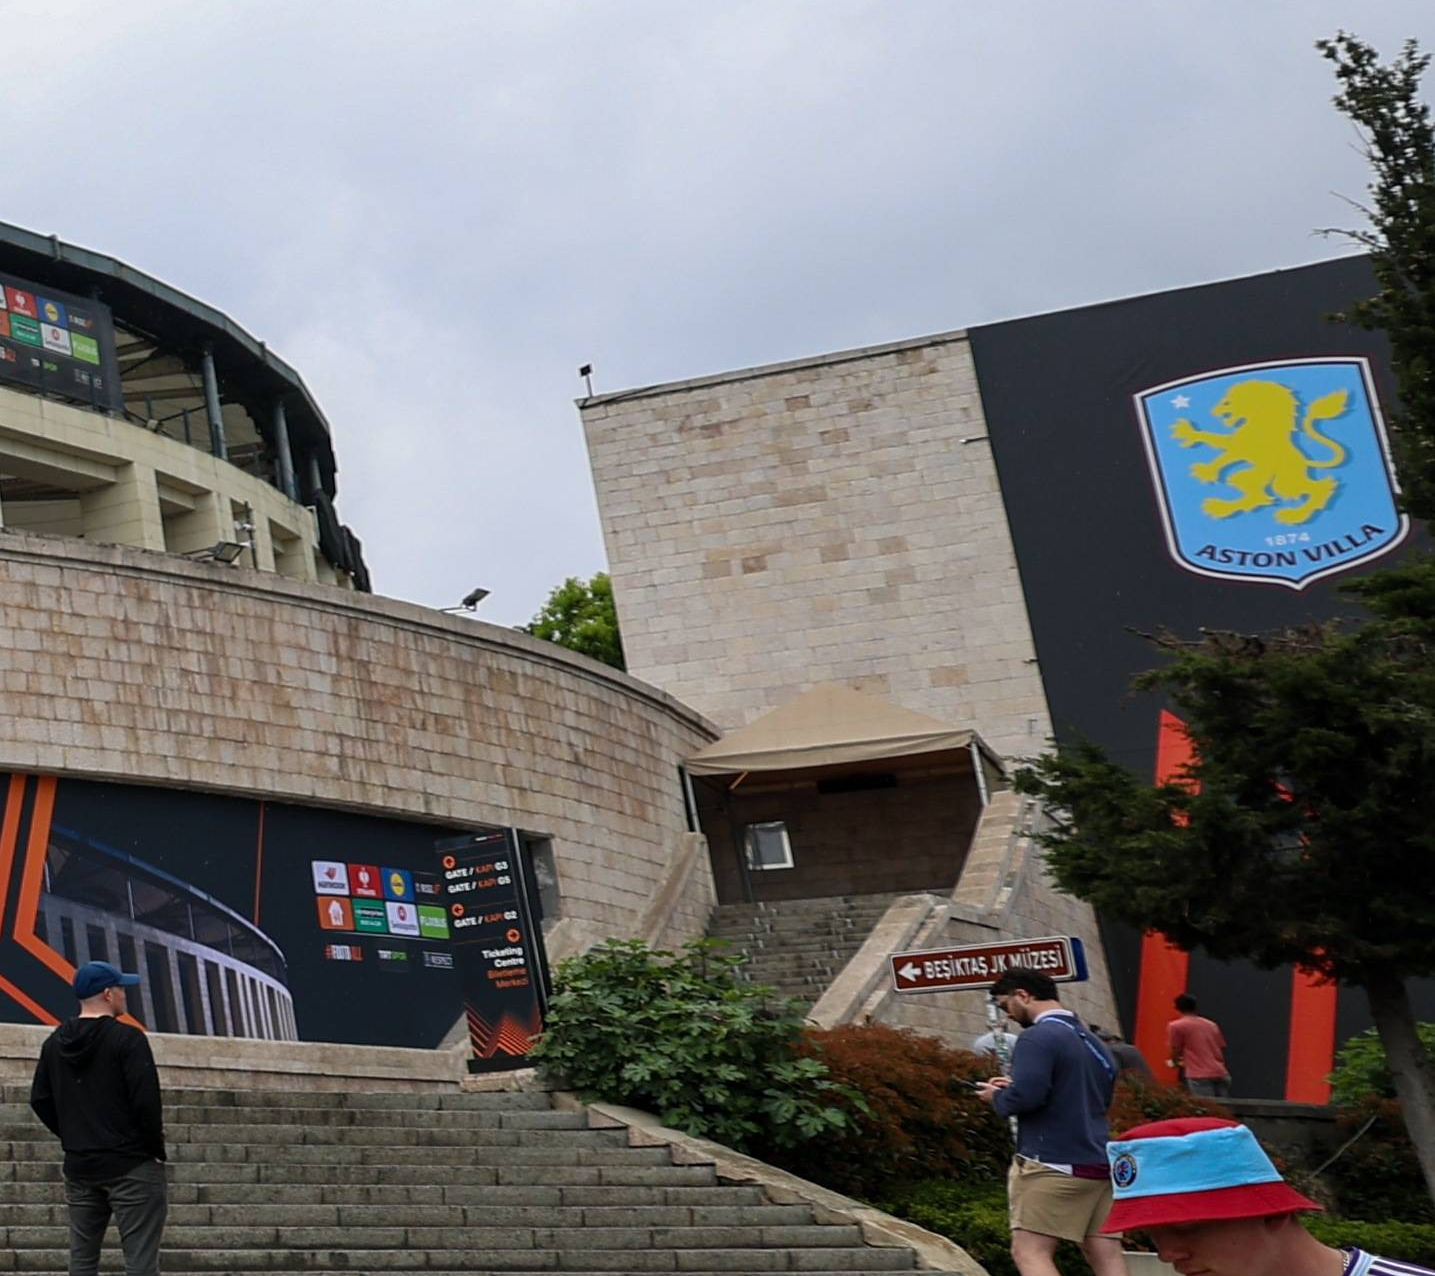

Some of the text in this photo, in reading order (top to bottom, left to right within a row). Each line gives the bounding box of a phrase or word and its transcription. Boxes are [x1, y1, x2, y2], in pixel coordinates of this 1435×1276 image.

[1195, 523, 1386, 568] ASTON VILLA
[1263, 532, 1311, 547] 1874
[444, 867, 469, 880] GATE
[447, 882, 472, 894] GATE
[453, 916, 477, 928] GATE
[503, 910, 518, 921] G2
[481, 947, 524, 959] Ticketing
[494, 957, 526, 968] Centre
[923, 944, 1064, 980] BEŞİKTAŞ JK MÜZESİ
